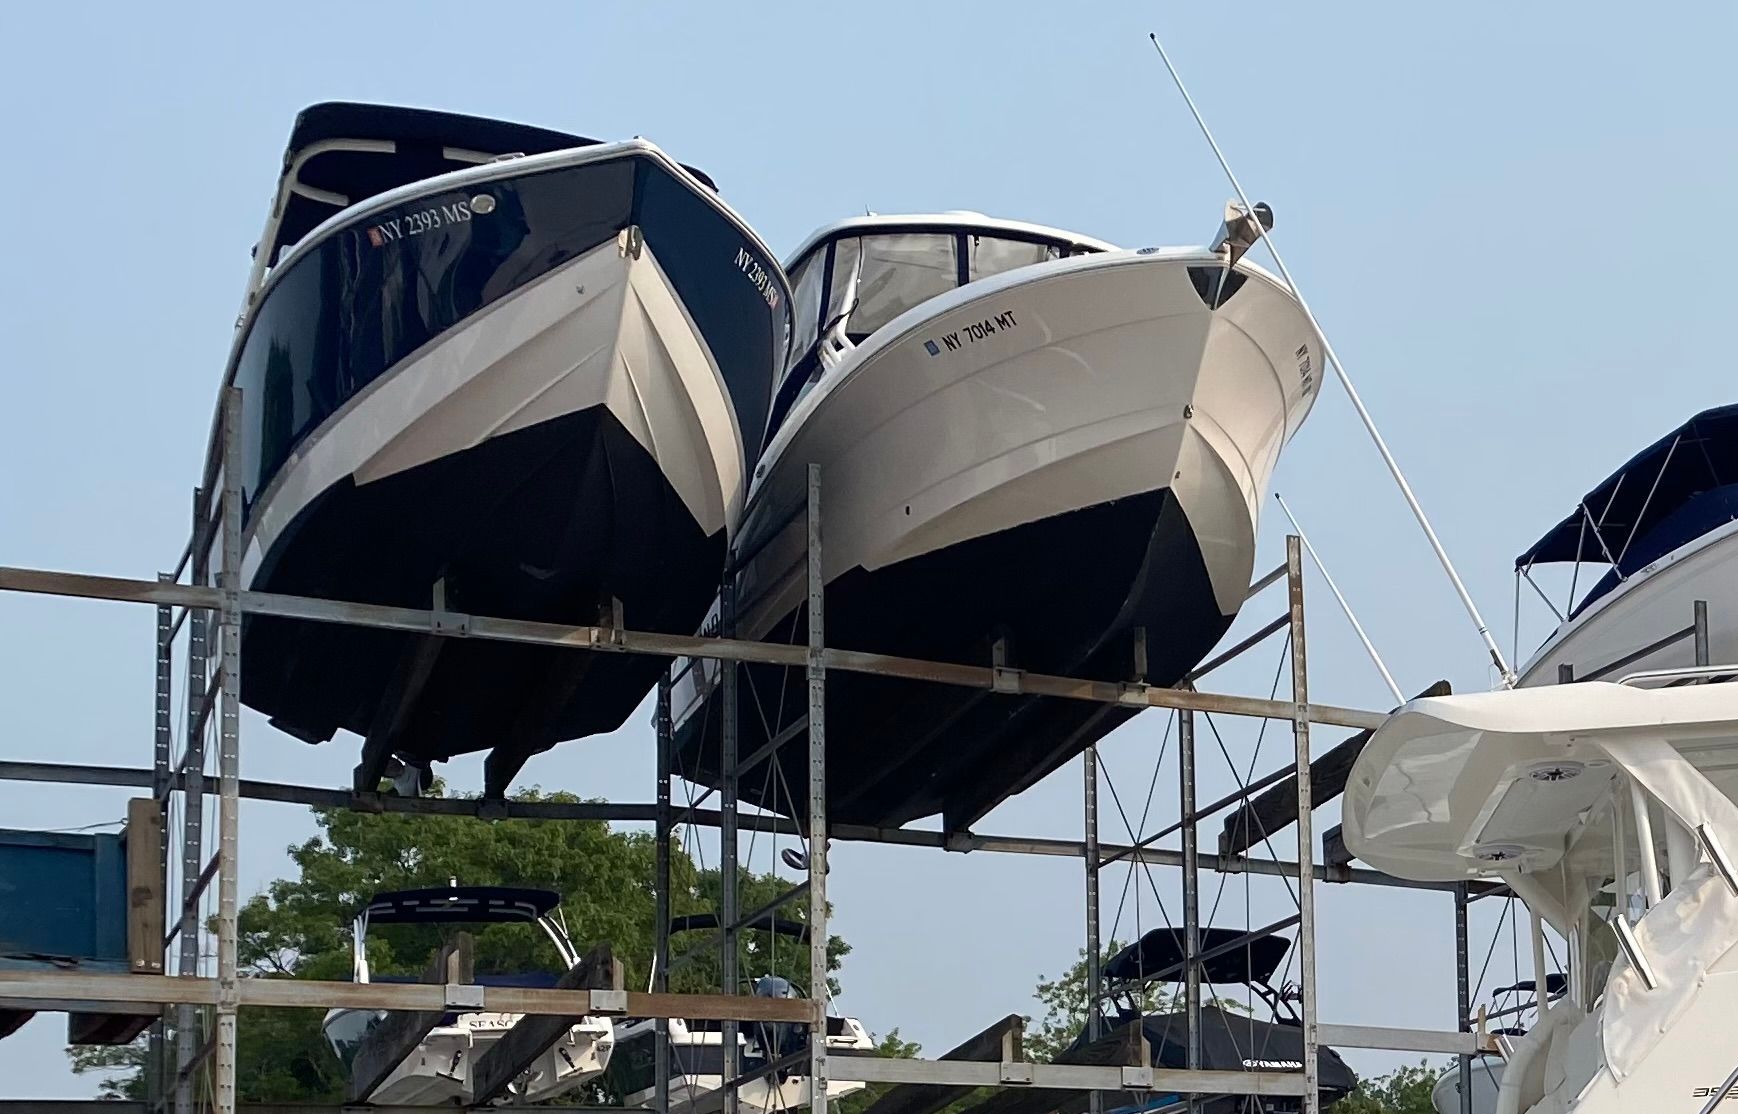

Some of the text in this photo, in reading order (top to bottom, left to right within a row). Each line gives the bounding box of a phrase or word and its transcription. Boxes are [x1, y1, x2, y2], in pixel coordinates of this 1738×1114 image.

[379, 201, 471, 244] NY 2393 MS
[734, 247, 754, 272] NY
[942, 310, 1017, 352] NY 7014 MT
